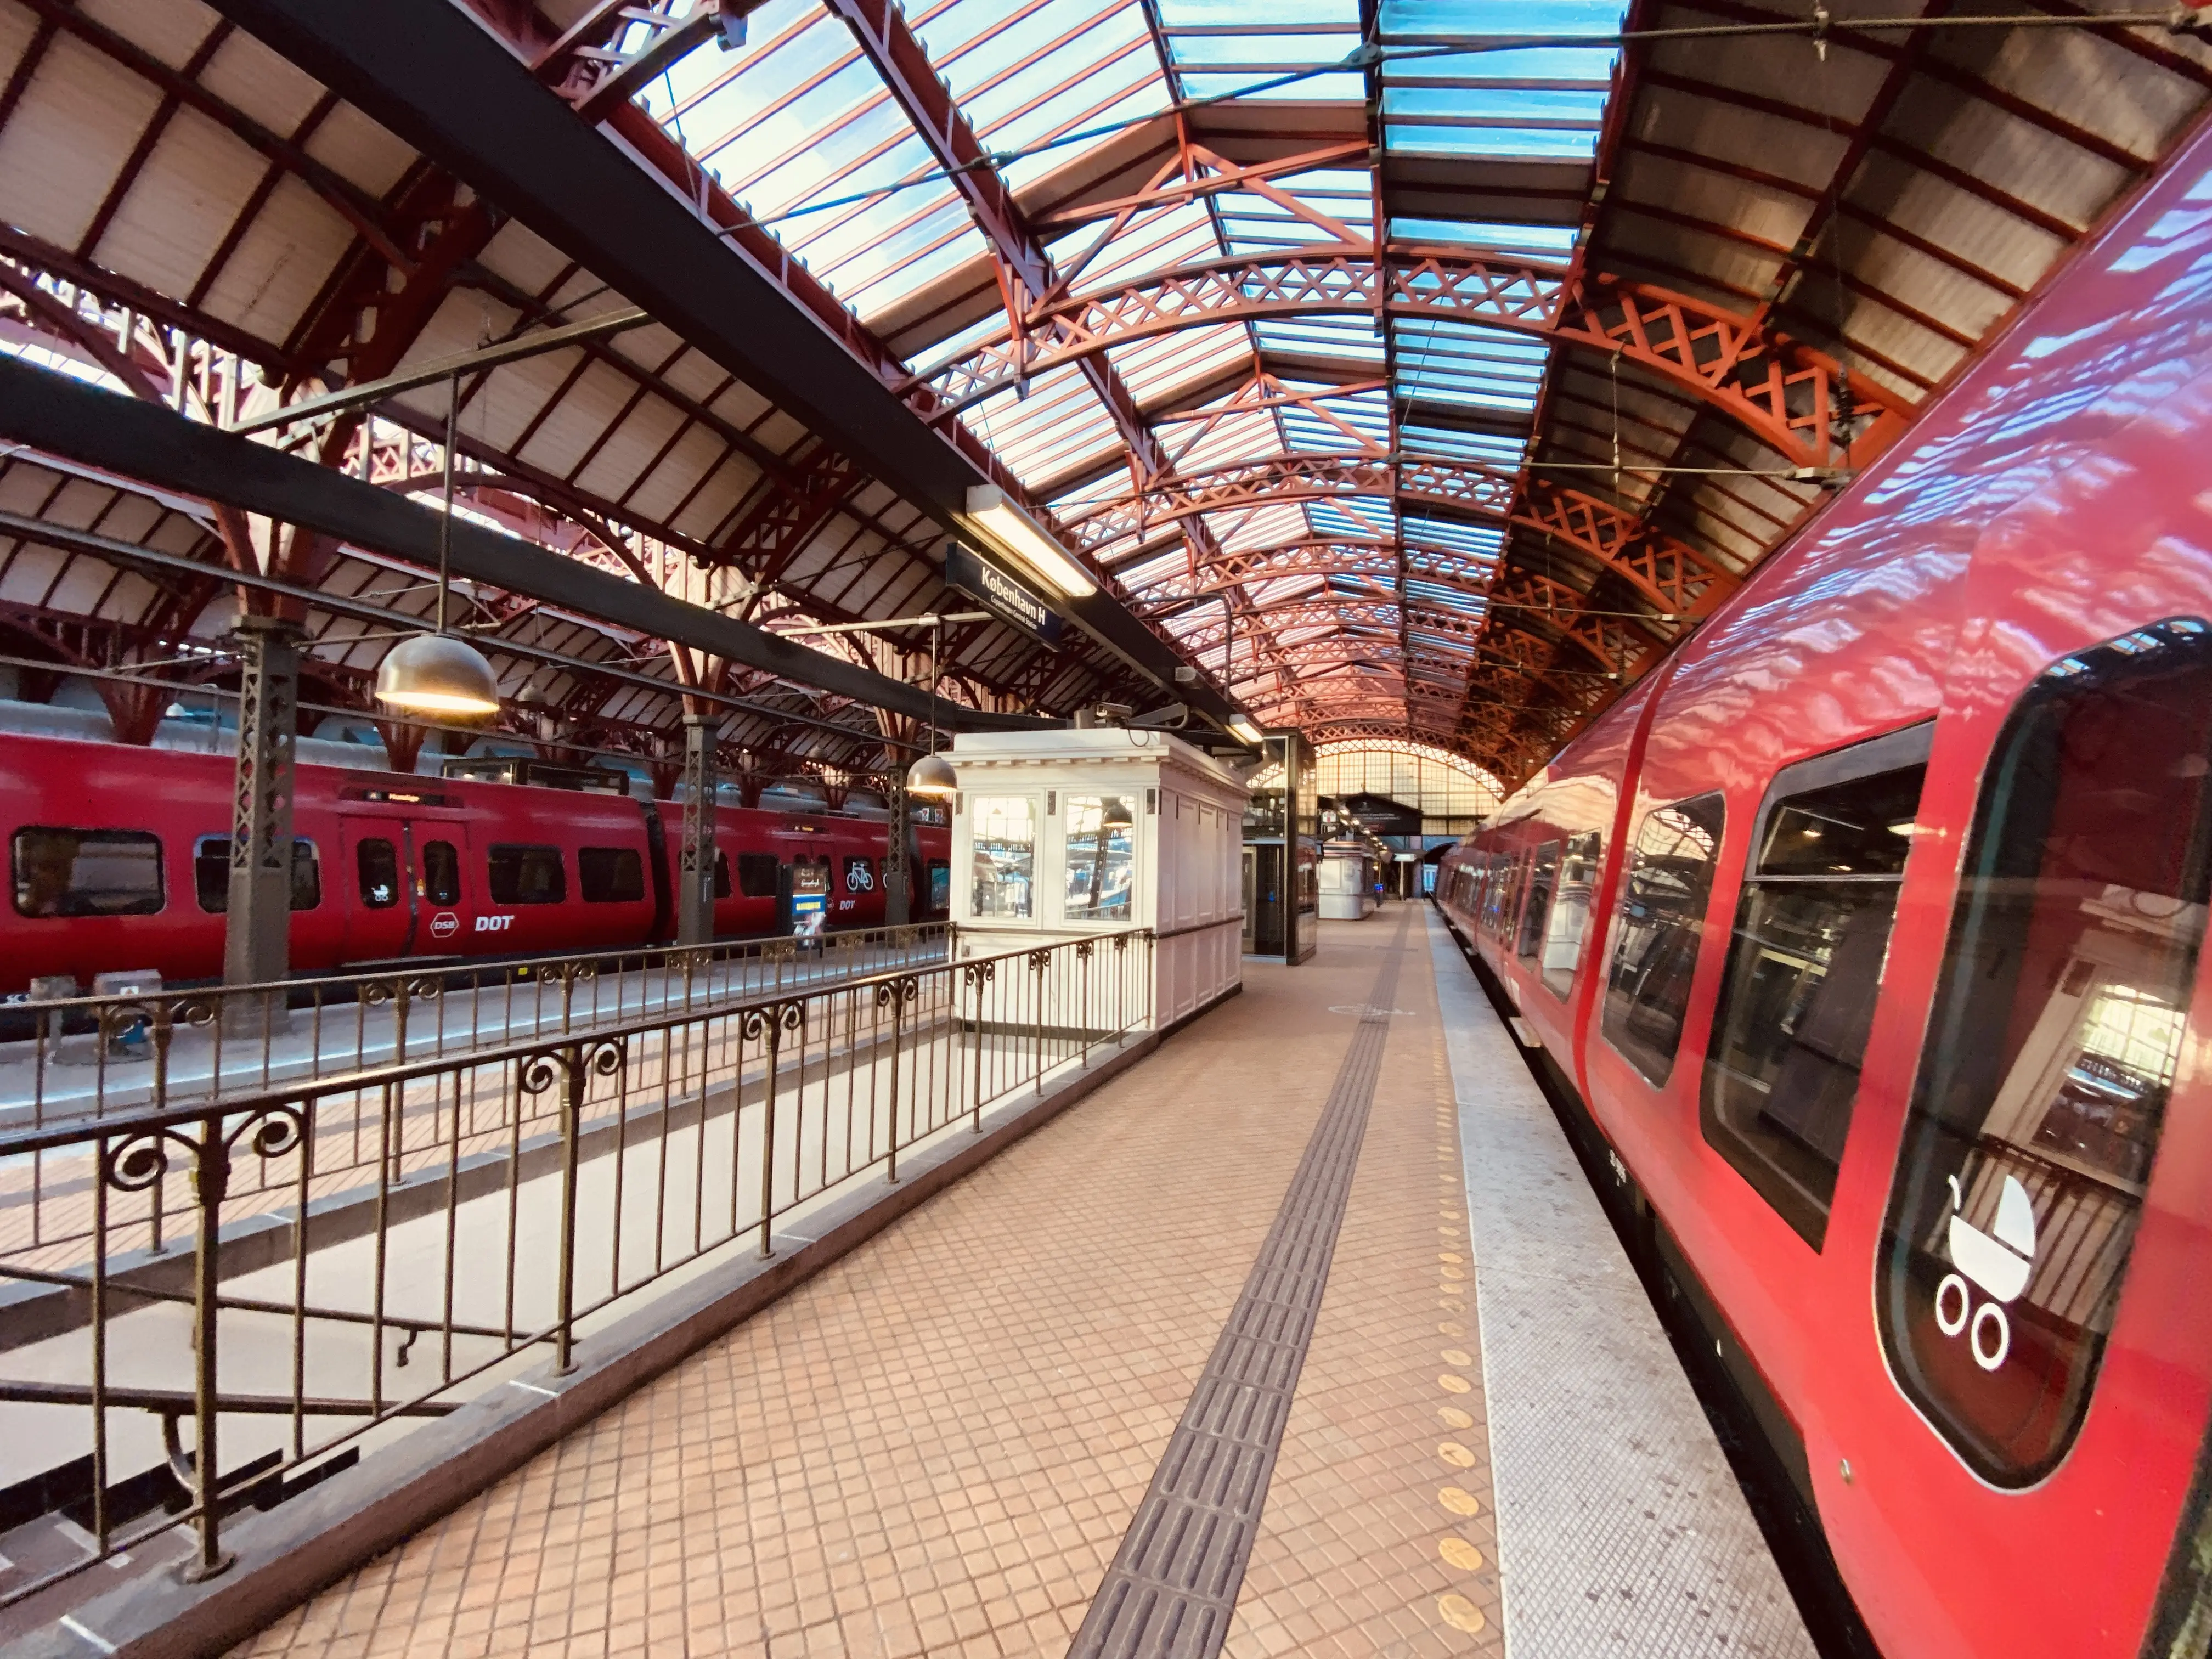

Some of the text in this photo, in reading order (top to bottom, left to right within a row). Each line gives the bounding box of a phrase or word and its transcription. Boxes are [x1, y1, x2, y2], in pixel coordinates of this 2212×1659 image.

[982, 566, 1045, 625] København H
[839, 900, 856, 910] DOT
[435, 921, 455, 929] DSB
[475, 915, 515, 931] DOT
